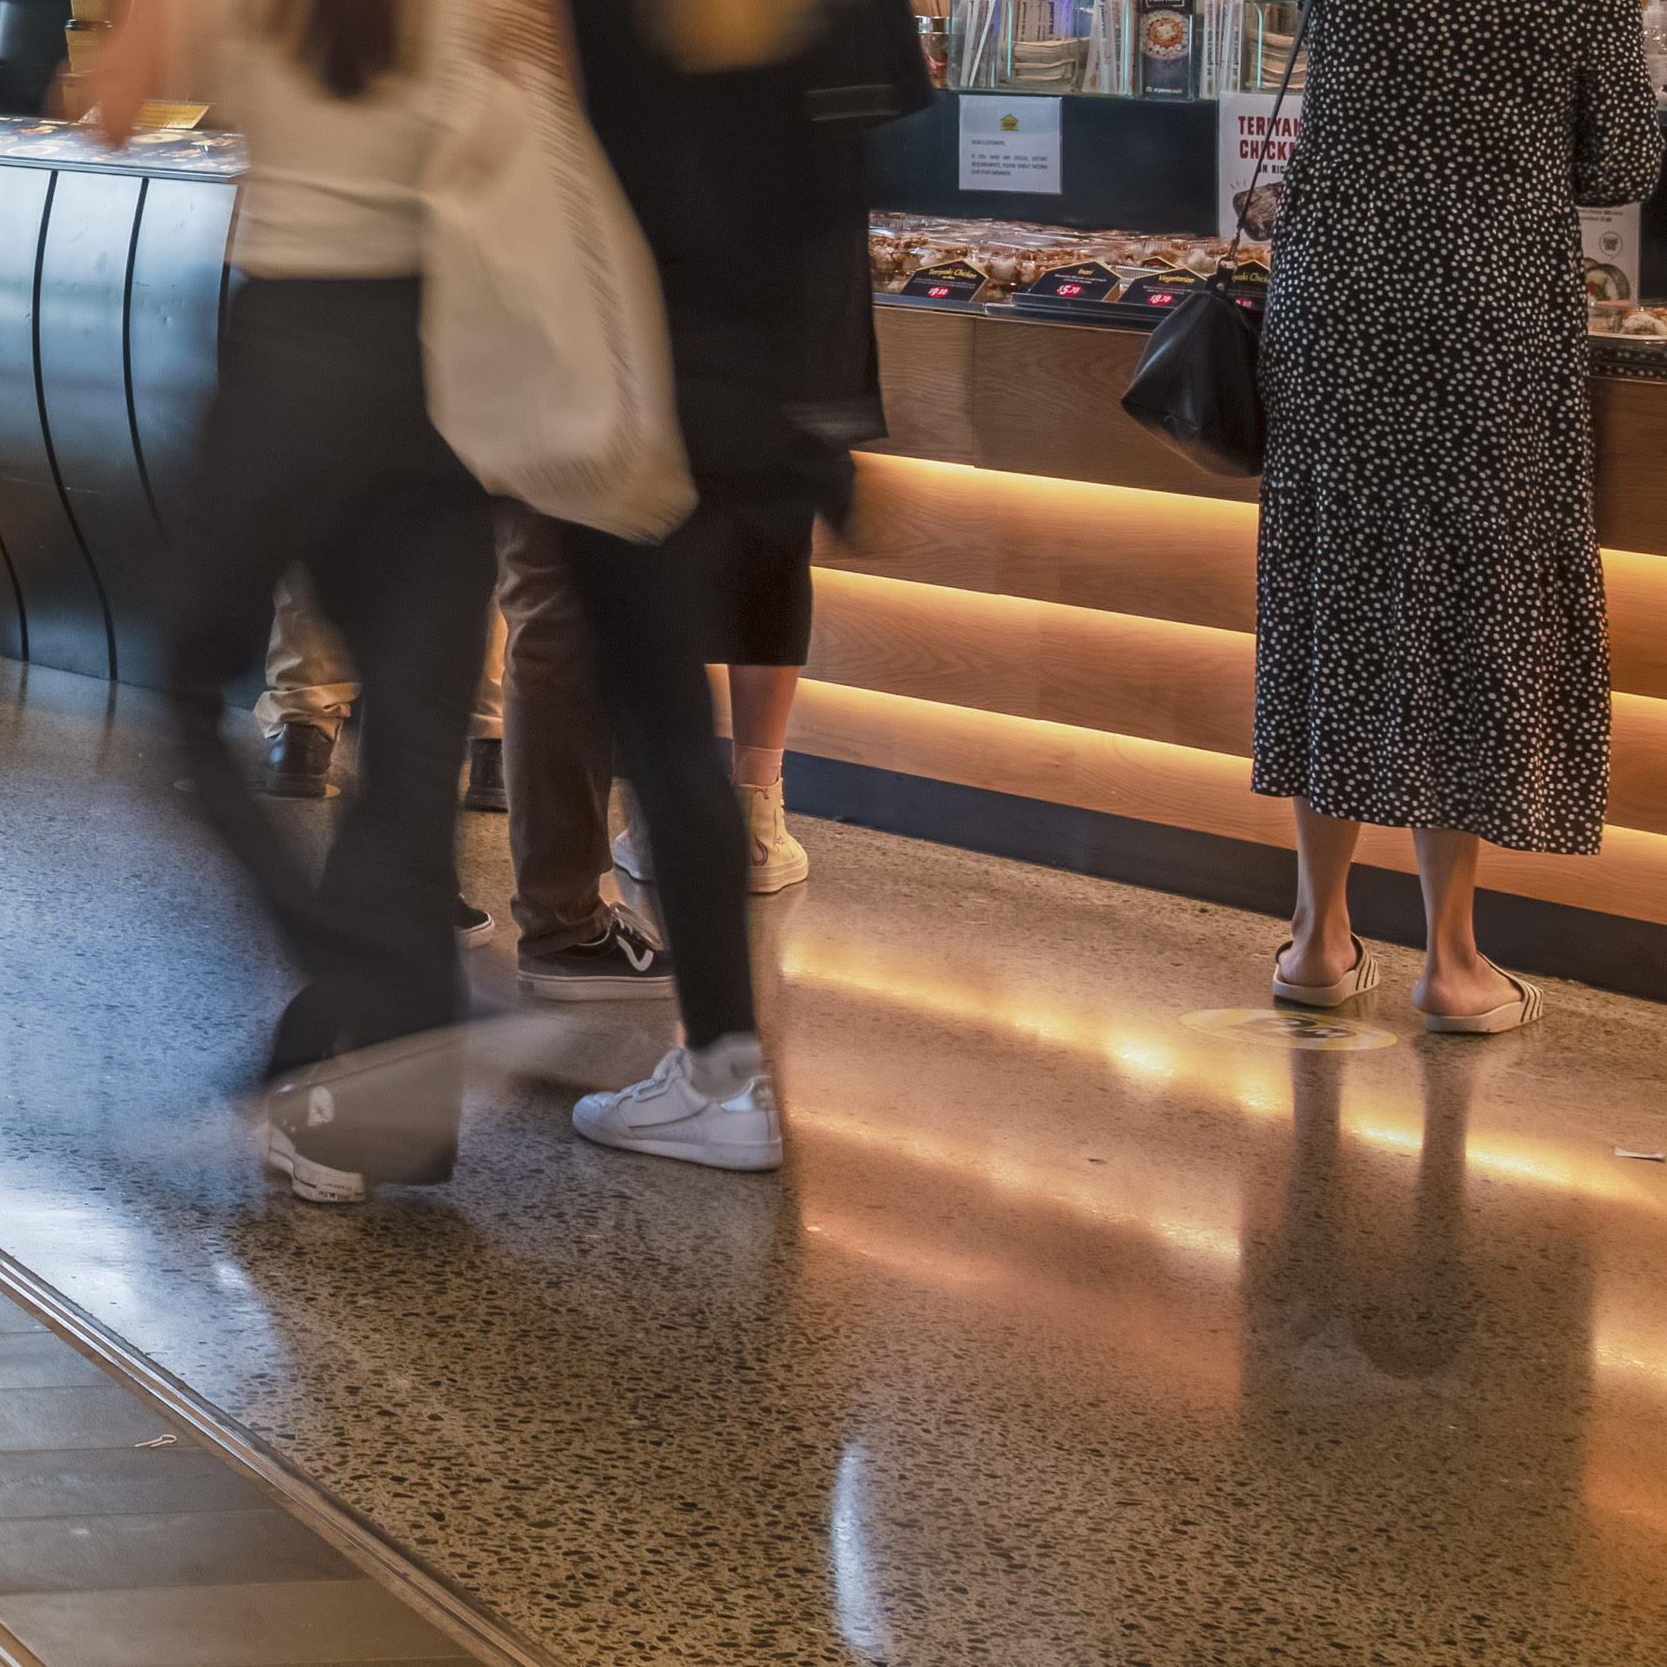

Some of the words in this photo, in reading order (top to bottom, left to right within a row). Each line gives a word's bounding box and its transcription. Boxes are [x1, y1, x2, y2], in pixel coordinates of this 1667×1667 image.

[1238, 115, 1299, 137] TERYA
[1239, 140, 1296, 161] CHCK
[1271, 165, 1286, 173] RIC
